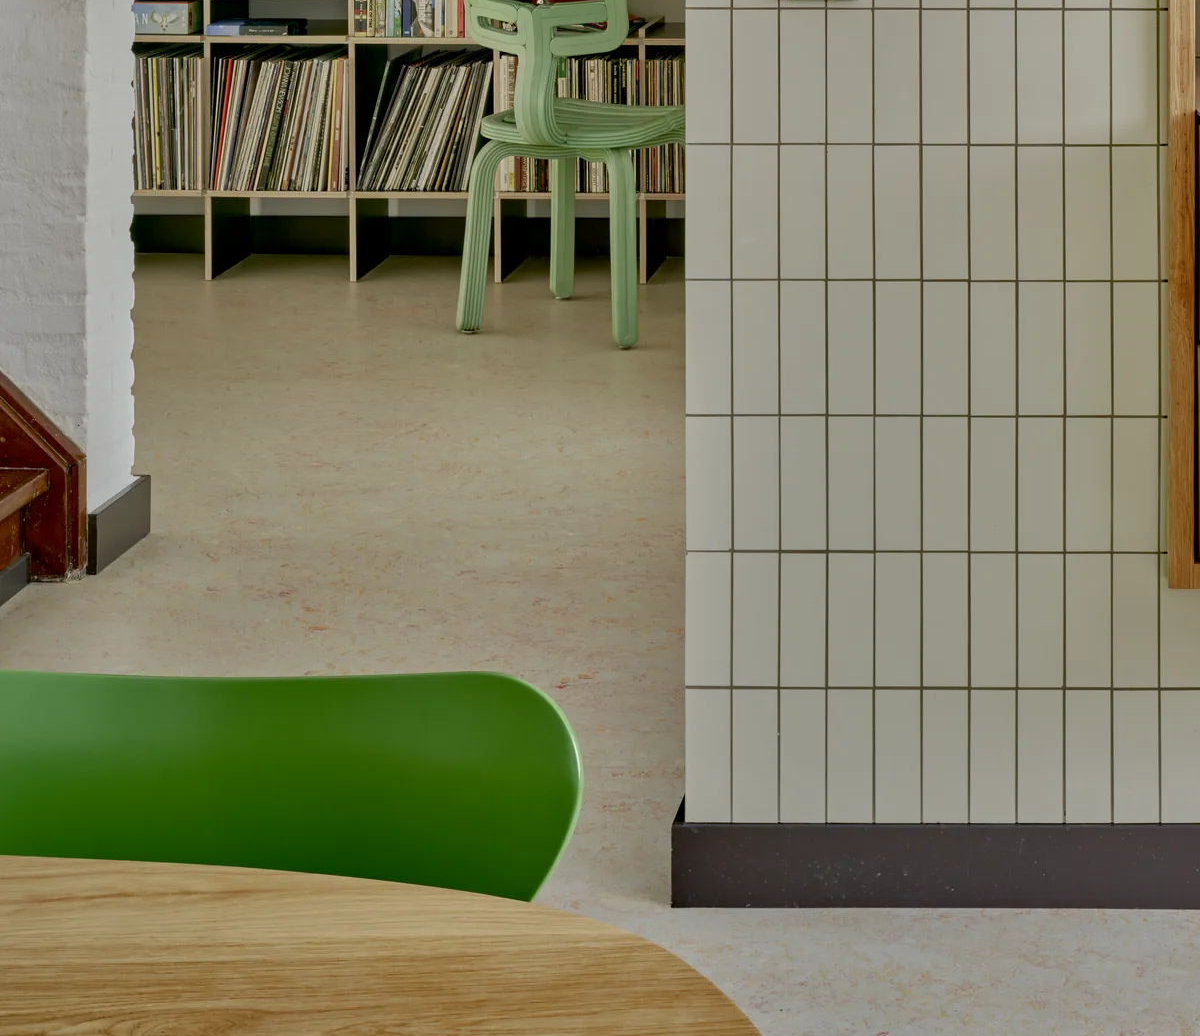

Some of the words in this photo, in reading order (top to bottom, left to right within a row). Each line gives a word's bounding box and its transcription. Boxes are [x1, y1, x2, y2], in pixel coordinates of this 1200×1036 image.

[135, 13, 149, 25] AN
[280, 66, 291, 88] JOANNA
[276, 88, 286, 113] NEWSOM
